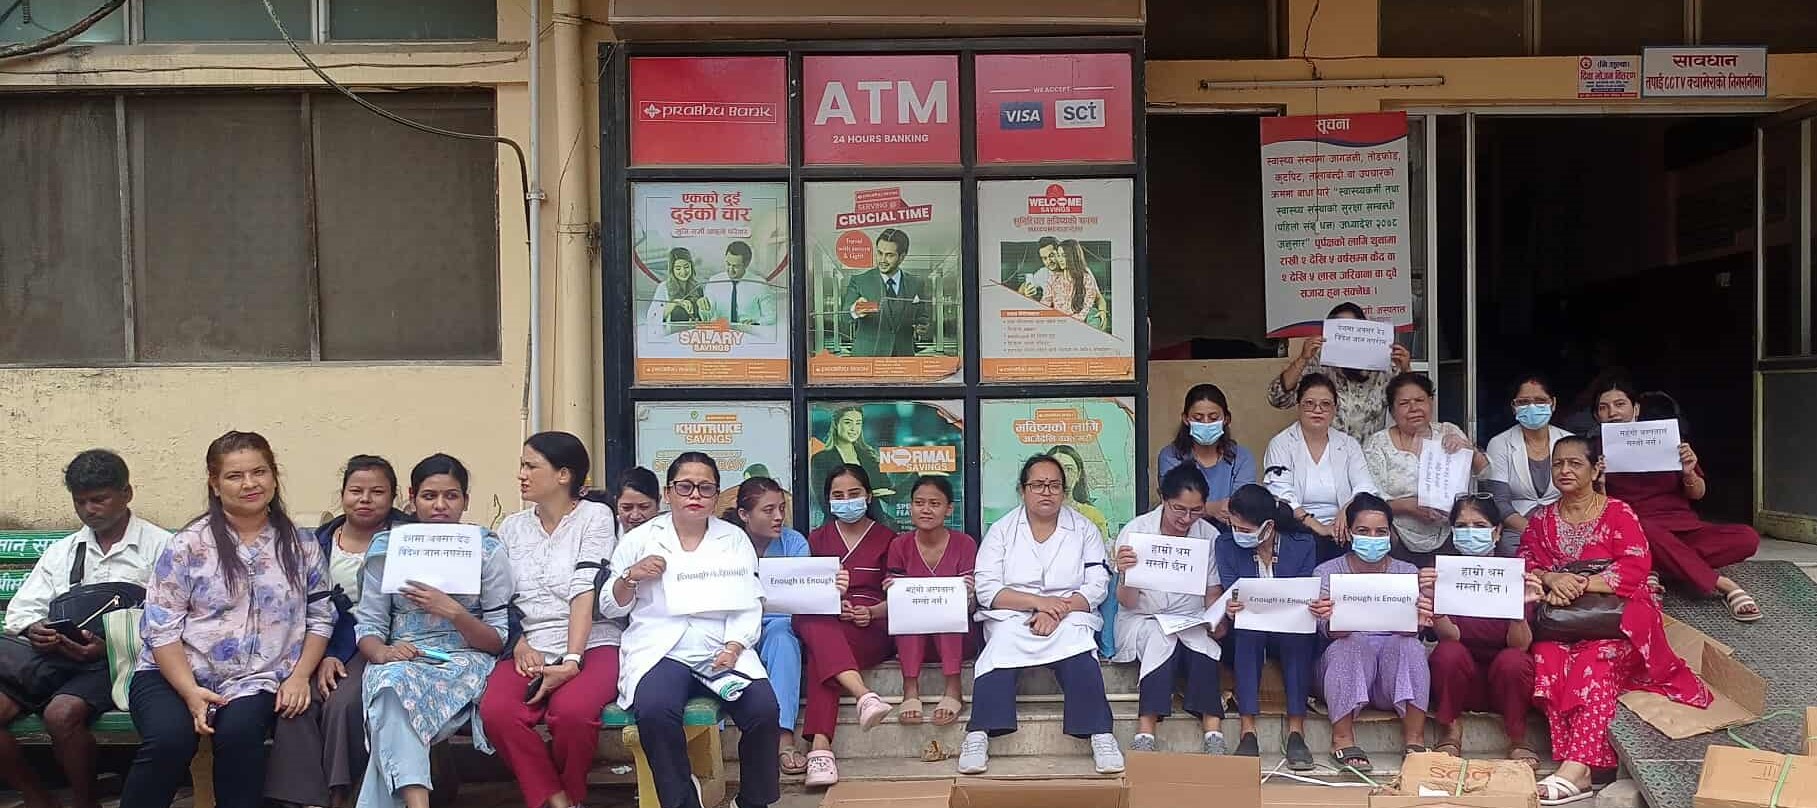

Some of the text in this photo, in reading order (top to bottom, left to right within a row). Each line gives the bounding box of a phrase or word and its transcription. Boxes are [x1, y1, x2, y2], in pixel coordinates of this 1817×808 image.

[1672, 55, 1738, 68] सावधान
[814, 80, 948, 125] ATM
[1004, 109, 1041, 123] VISA
[1316, 118, 1350, 134] सूचना
[833, 134, 929, 144] 24 HOURS BANKING
[1348, 170, 1356, 179] वा
[682, 190, 718, 204] एकको
[670, 204, 717, 224] दुईको
[839, 207, 930, 226] CRUCIAL TIME
[1388, 253, 1395, 261] वा
[1375, 270, 1383, 278] वा
[679, 331, 743, 345] SALARY
[694, 344, 730, 352] SAVINGS
[675, 423, 743, 435] KHUTRUKE
[686, 434, 732, 444] SAVINGS
[906, 463, 947, 472] SAVINGS
[1151, 542, 1193, 557] हाम्रो श्रम
[1461, 565, 1505, 578] हाम्रो श्रम
[770, 576, 798, 587] Enough
[806, 576, 834, 587] Enough
[1455, 580, 1482, 593] सस्तो
[1484, 582, 1502, 594] छैन
[1250, 597, 1278, 605] Enough
[1343, 594, 1411, 604] Enough is Enough
